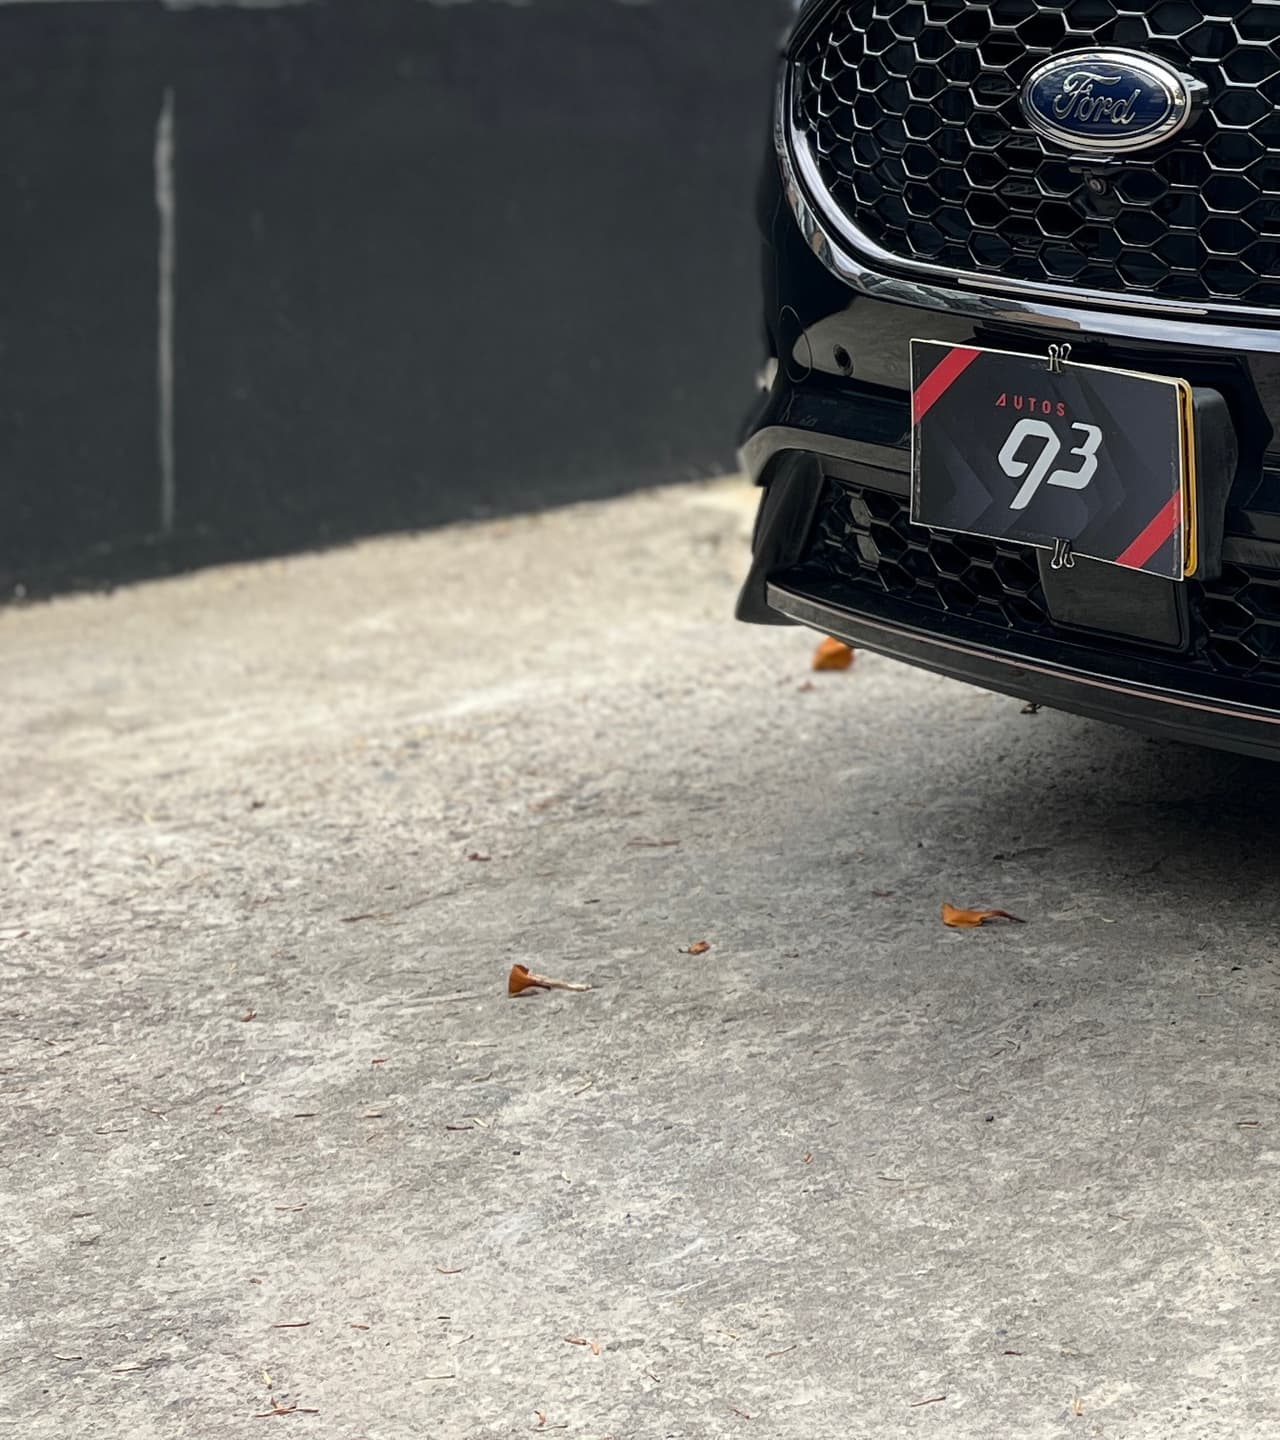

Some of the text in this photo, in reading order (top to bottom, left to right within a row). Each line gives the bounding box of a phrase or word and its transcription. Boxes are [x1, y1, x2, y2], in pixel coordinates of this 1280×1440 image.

[1053, 70, 1142, 125] Ford
[995, 392, 1066, 417] AUTOS
[997, 417, 1103, 511] 93
